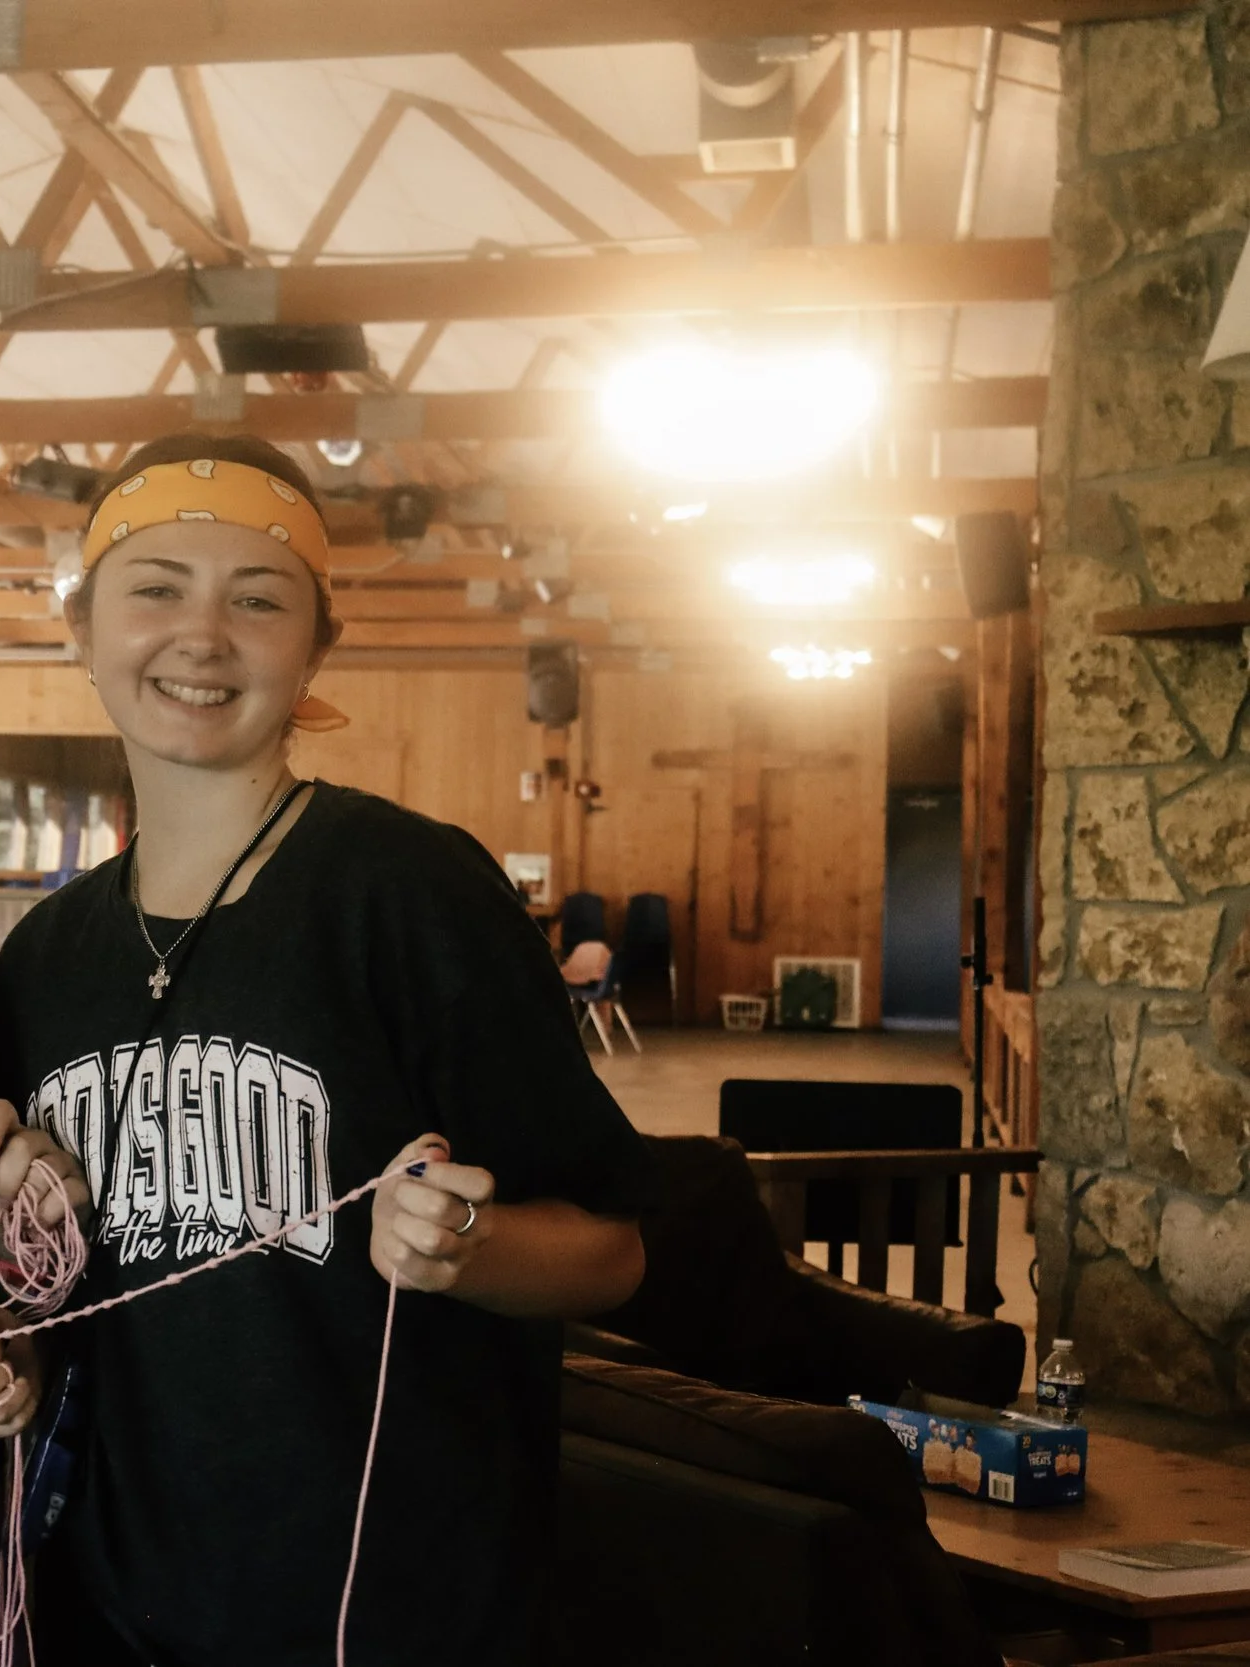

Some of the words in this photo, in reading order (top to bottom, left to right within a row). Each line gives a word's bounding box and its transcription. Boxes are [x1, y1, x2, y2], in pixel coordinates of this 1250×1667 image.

[107, 1037, 166, 1233] IS
[168, 1034, 334, 1266] GOOD
[114, 1209, 167, 1266] the
[170, 1204, 269, 1261] time
